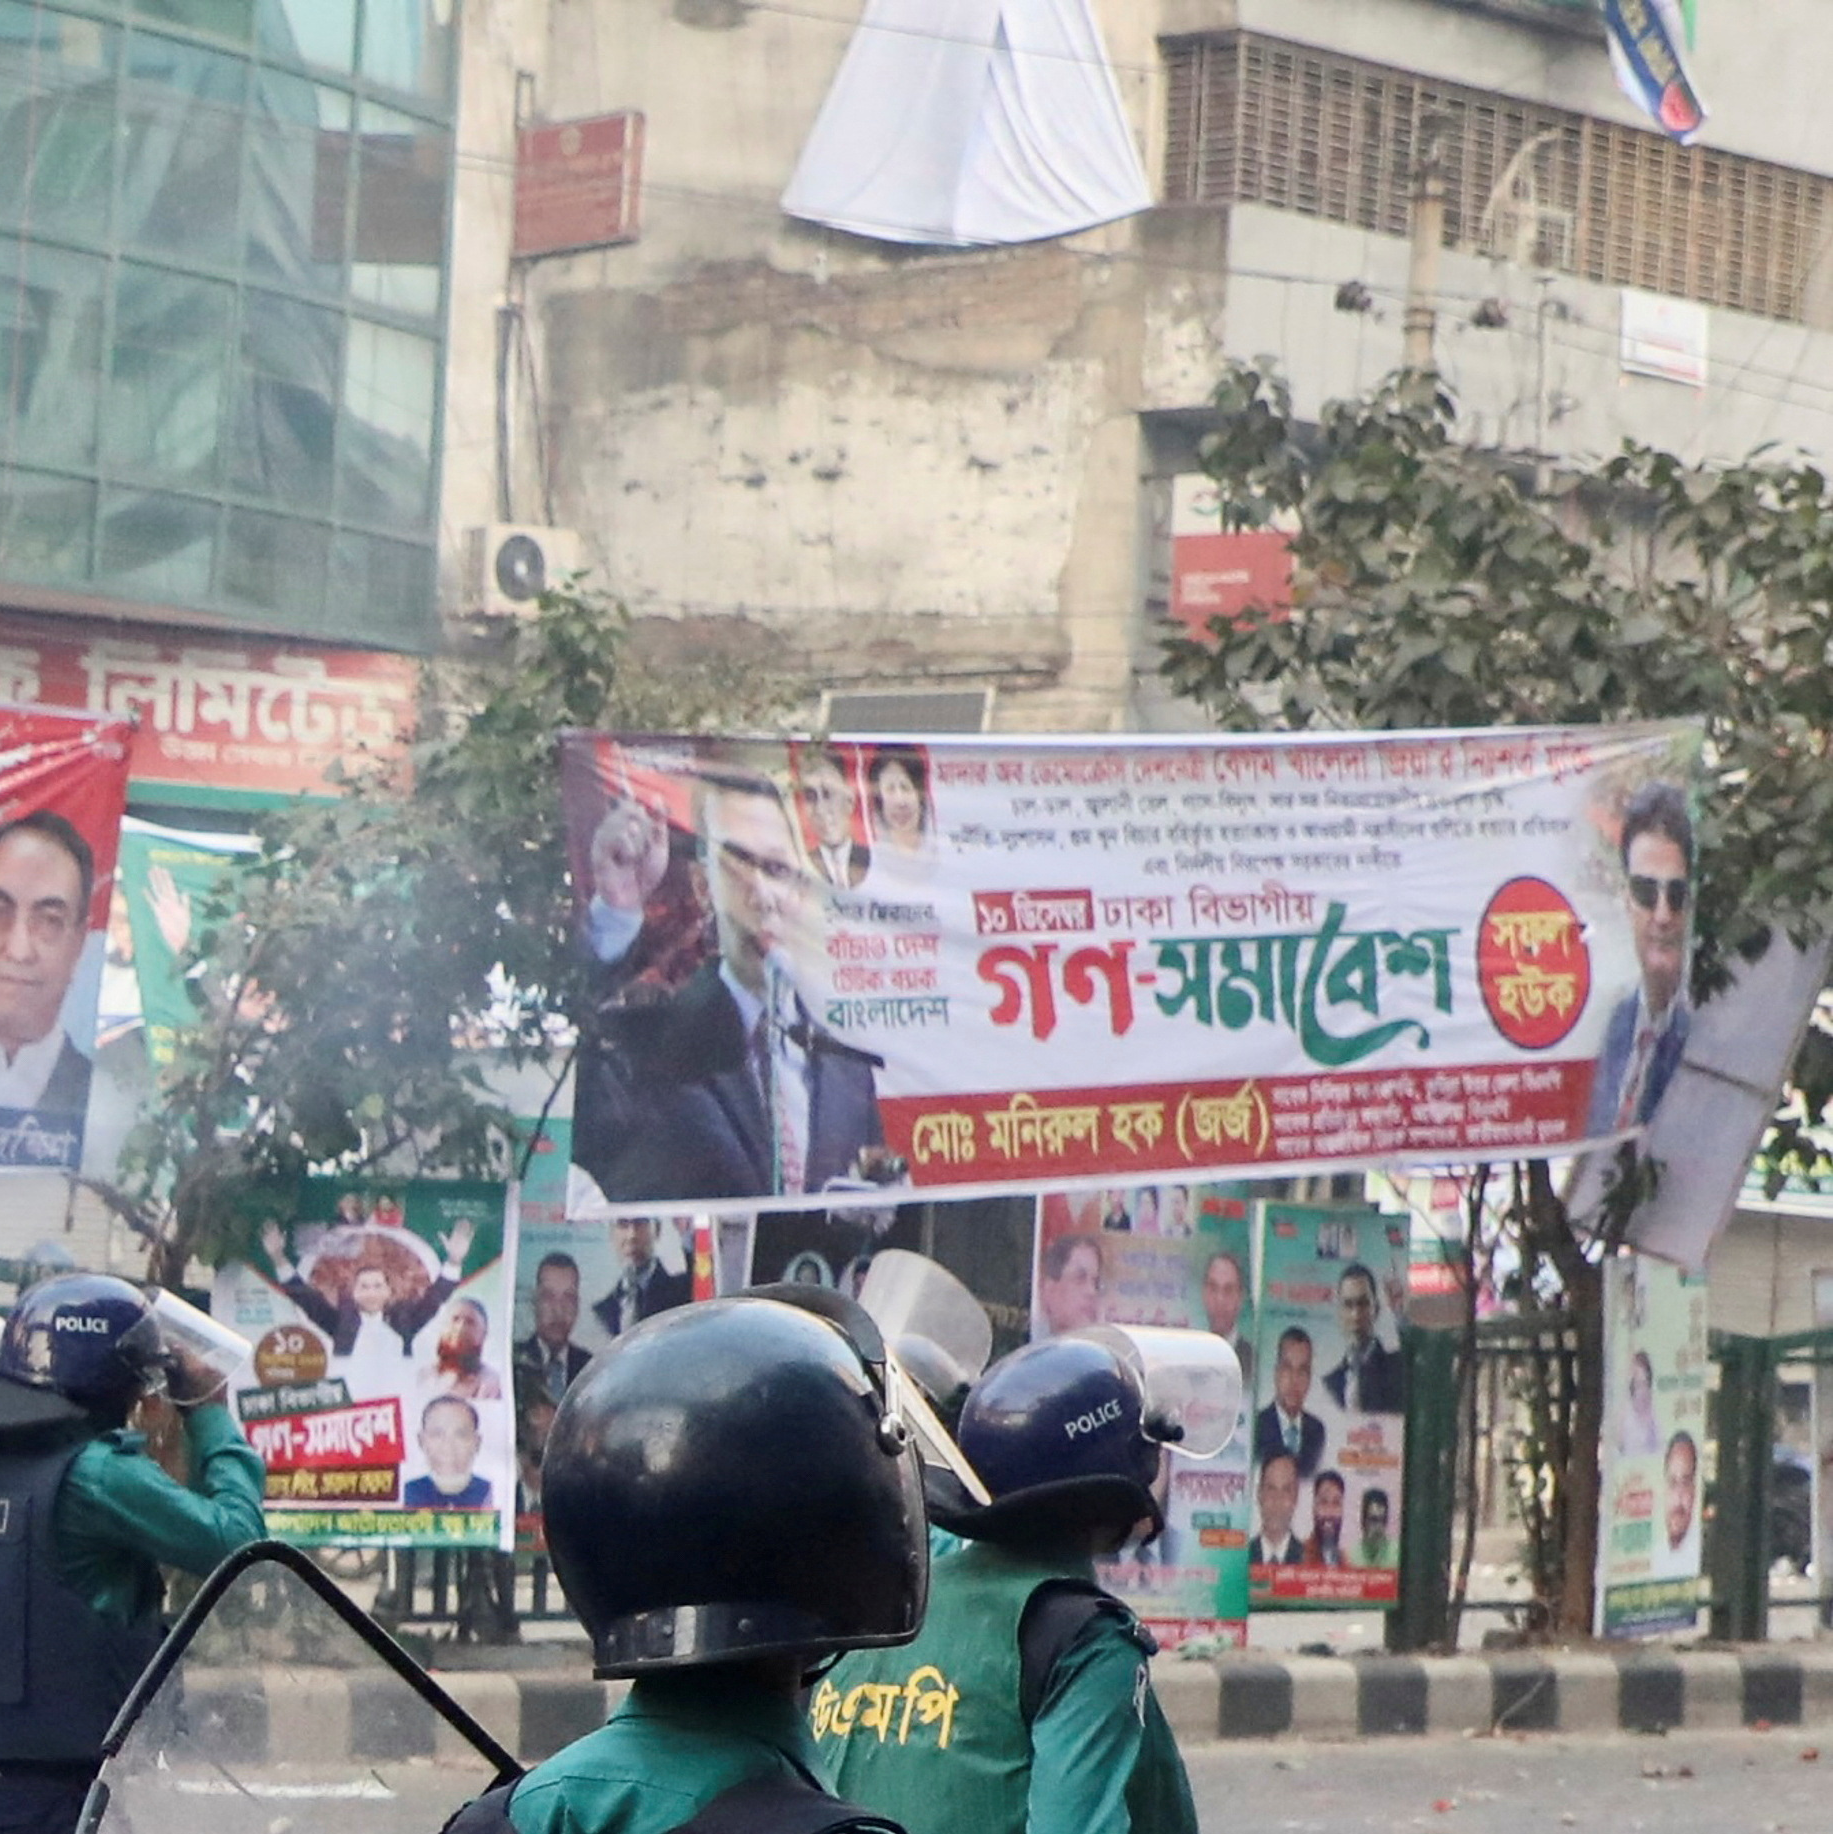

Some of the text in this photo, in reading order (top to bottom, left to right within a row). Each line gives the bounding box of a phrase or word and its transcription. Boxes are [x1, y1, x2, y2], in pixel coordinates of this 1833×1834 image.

[81, 640, 411, 750] লিমিটেড
[1102, 894, 1177, 931] ঢাকা
[1186, 878, 1317, 929] বিভাগীয়
[1490, 910, 1573, 959] সফল
[976, 901, 1461, 1067] গণ-সমাবেশ
[1494, 959, 1576, 1024] হউক
[826, 996, 951, 1033] বাংলাদেশ
[912, 1109, 978, 1167] মোঃ
[988, 1092, 1100, 1160] মনিরুল
[1109, 1100, 1165, 1153] হক
[54, 1315, 111, 1335] POLICE
[1064, 1398, 1124, 1441] POLICE
